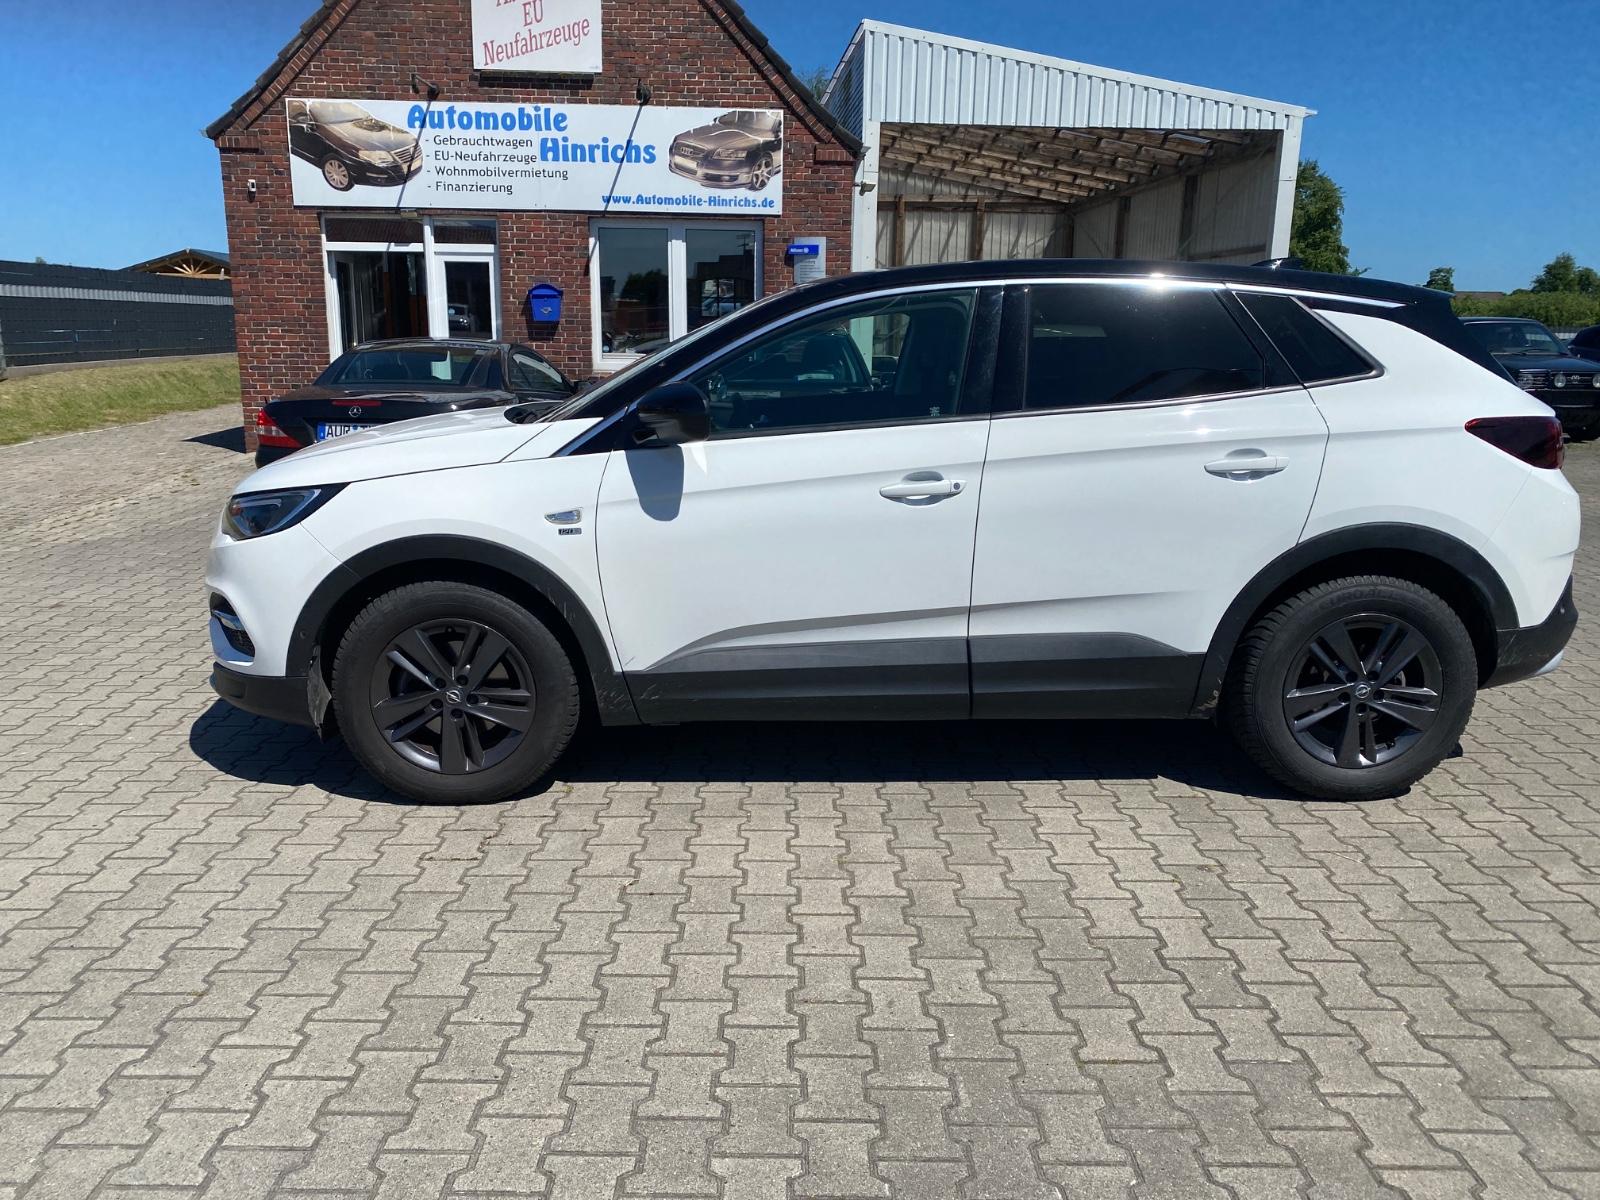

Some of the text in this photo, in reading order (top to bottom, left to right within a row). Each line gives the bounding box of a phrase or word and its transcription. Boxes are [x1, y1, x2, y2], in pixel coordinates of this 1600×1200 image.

[522, 0, 544, 27] EU
[483, 18, 590, 66] Neufahrzeuge
[407, 104, 568, 131] Automobile
[433, 135, 533, 148] Gebrauchtwagen
[539, 136, 657, 163] Hinrichs
[434, 151, 537, 164] EU-Neufahrzeuge
[435, 166, 568, 180] Wohnmobilvermietung
[435, 182, 513, 195] Finanzierung
[602, 194, 775, 208] www.Automobile-Hinrichs.de
